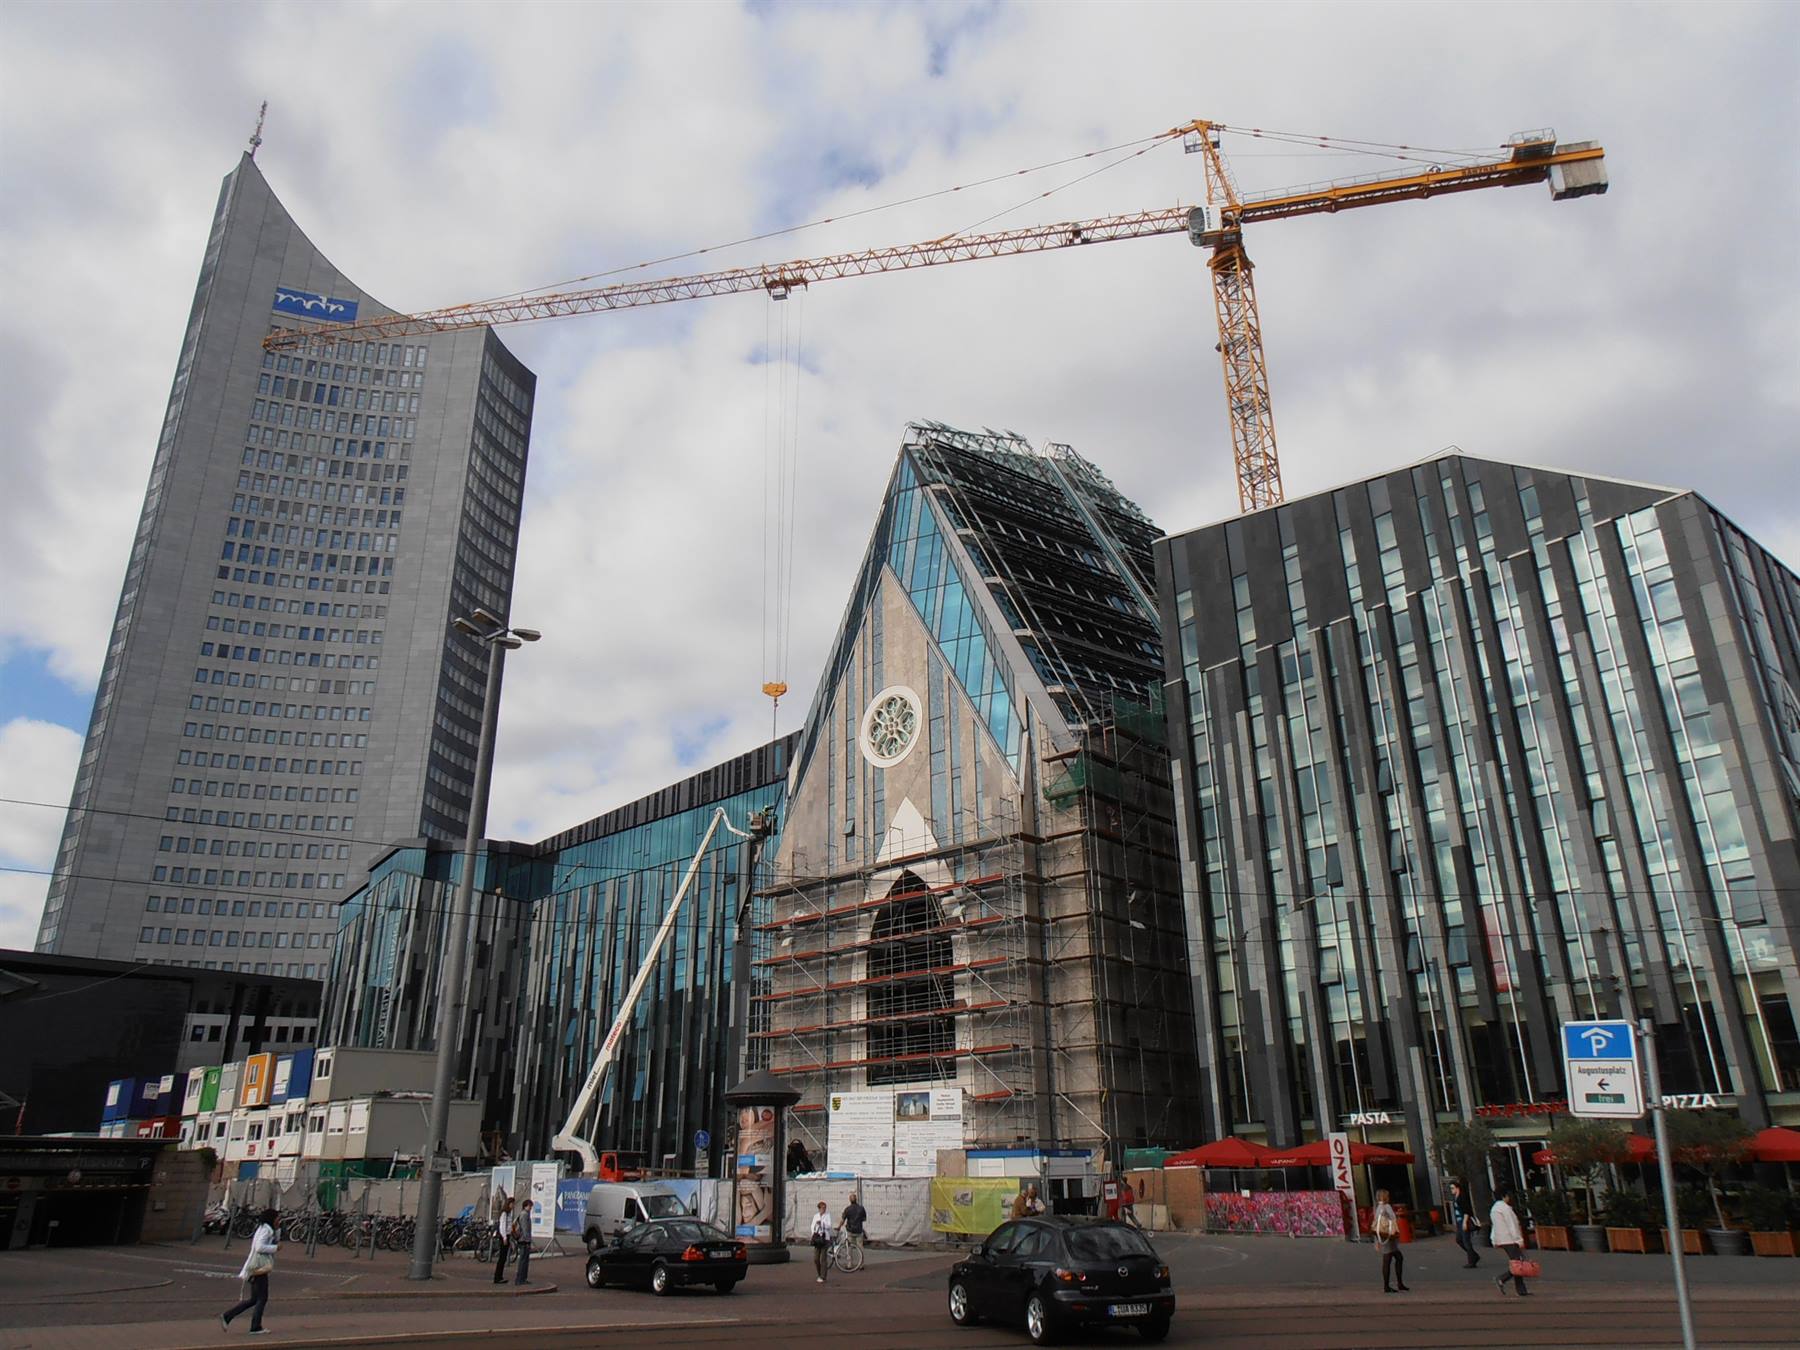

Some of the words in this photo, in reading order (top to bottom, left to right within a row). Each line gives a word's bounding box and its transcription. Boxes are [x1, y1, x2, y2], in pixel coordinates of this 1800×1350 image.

[275, 292, 345, 314] mdr
[605, 1022, 622, 1052] mateco
[1591, 1036, 1607, 1057] P
[1578, 1066, 1626, 1076] Augustusplatz
[1661, 1093, 1717, 1109] PIZZA
[1350, 1112, 1391, 1125] PASTA
